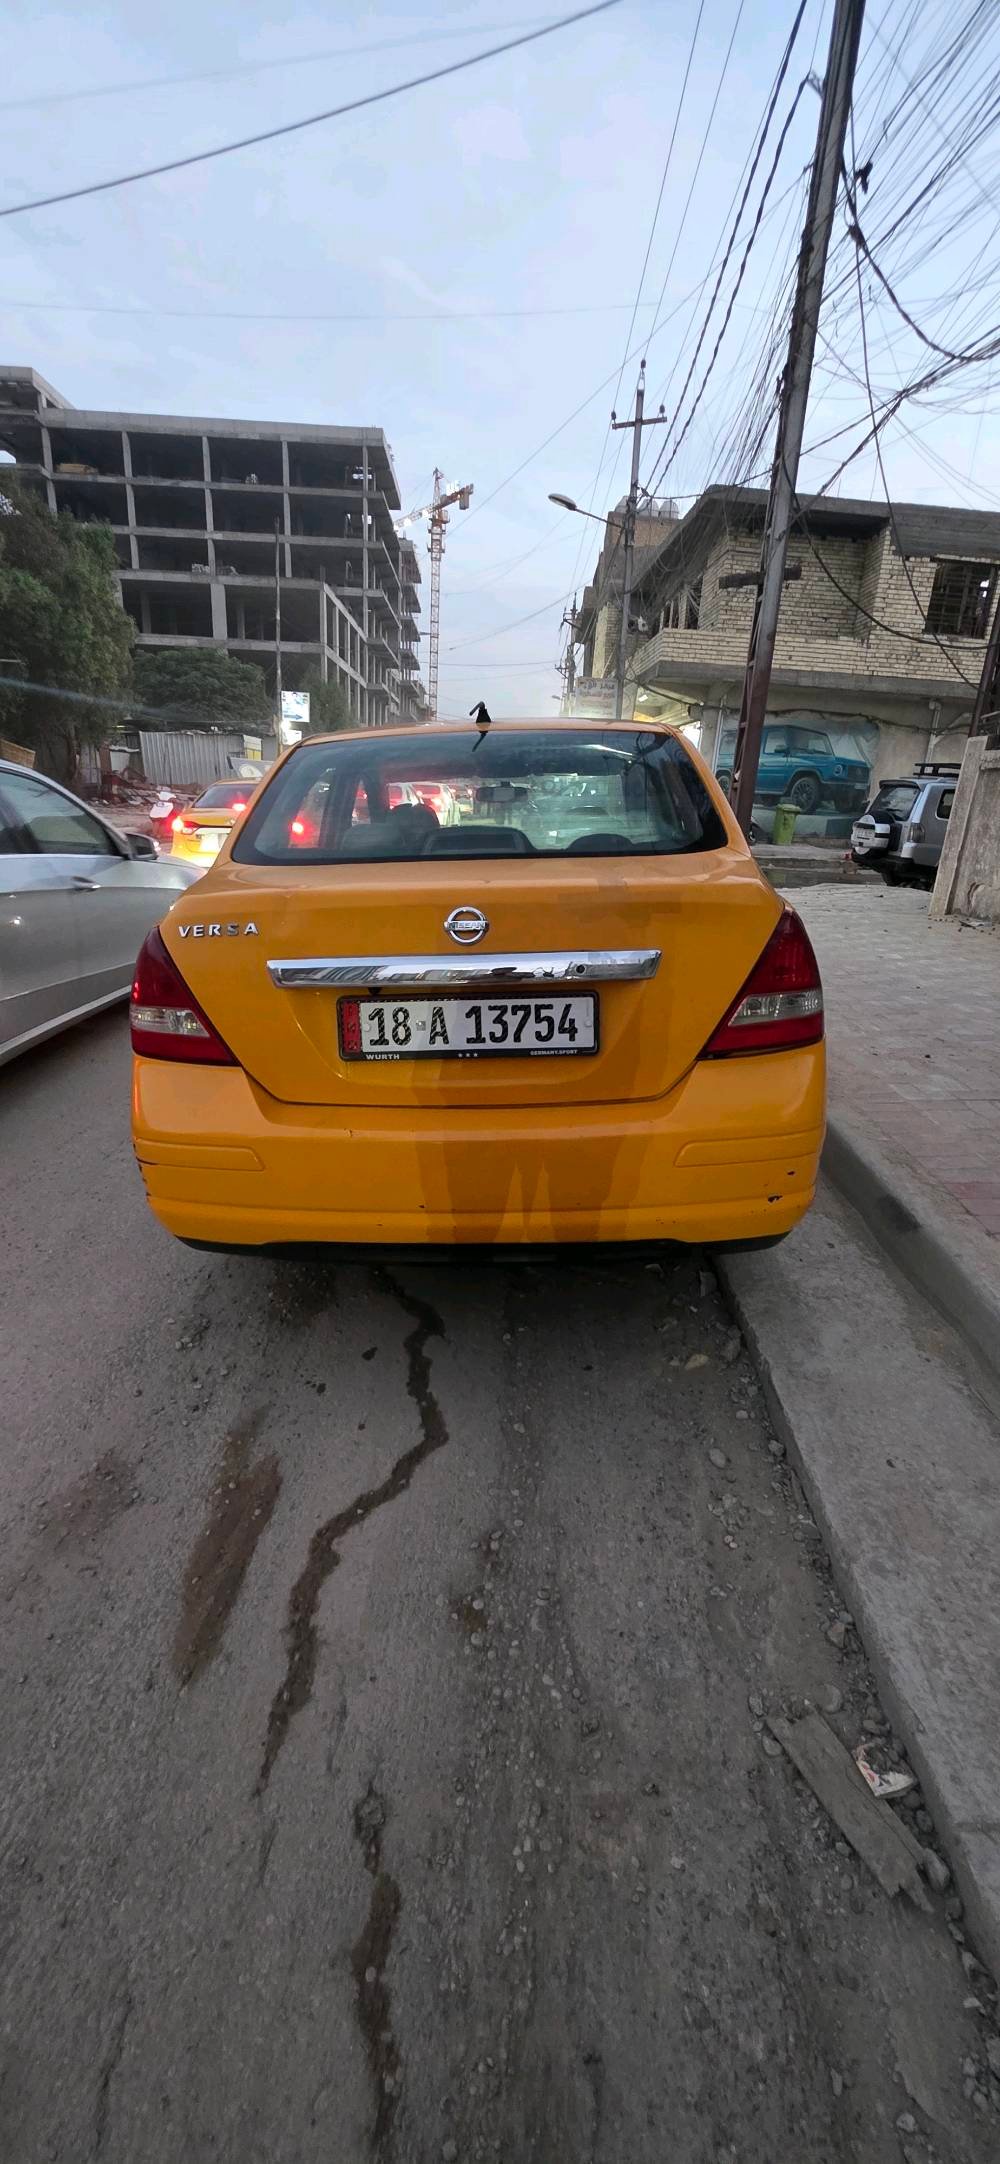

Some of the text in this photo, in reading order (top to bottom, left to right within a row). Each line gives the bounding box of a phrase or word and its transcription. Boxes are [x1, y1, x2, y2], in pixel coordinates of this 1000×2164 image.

[178, 922, 259, 938] VERSA
[368, 1006, 412, 1046] 18
[428, 1006, 450, 1045] A
[464, 1003, 578, 1044] 13754
